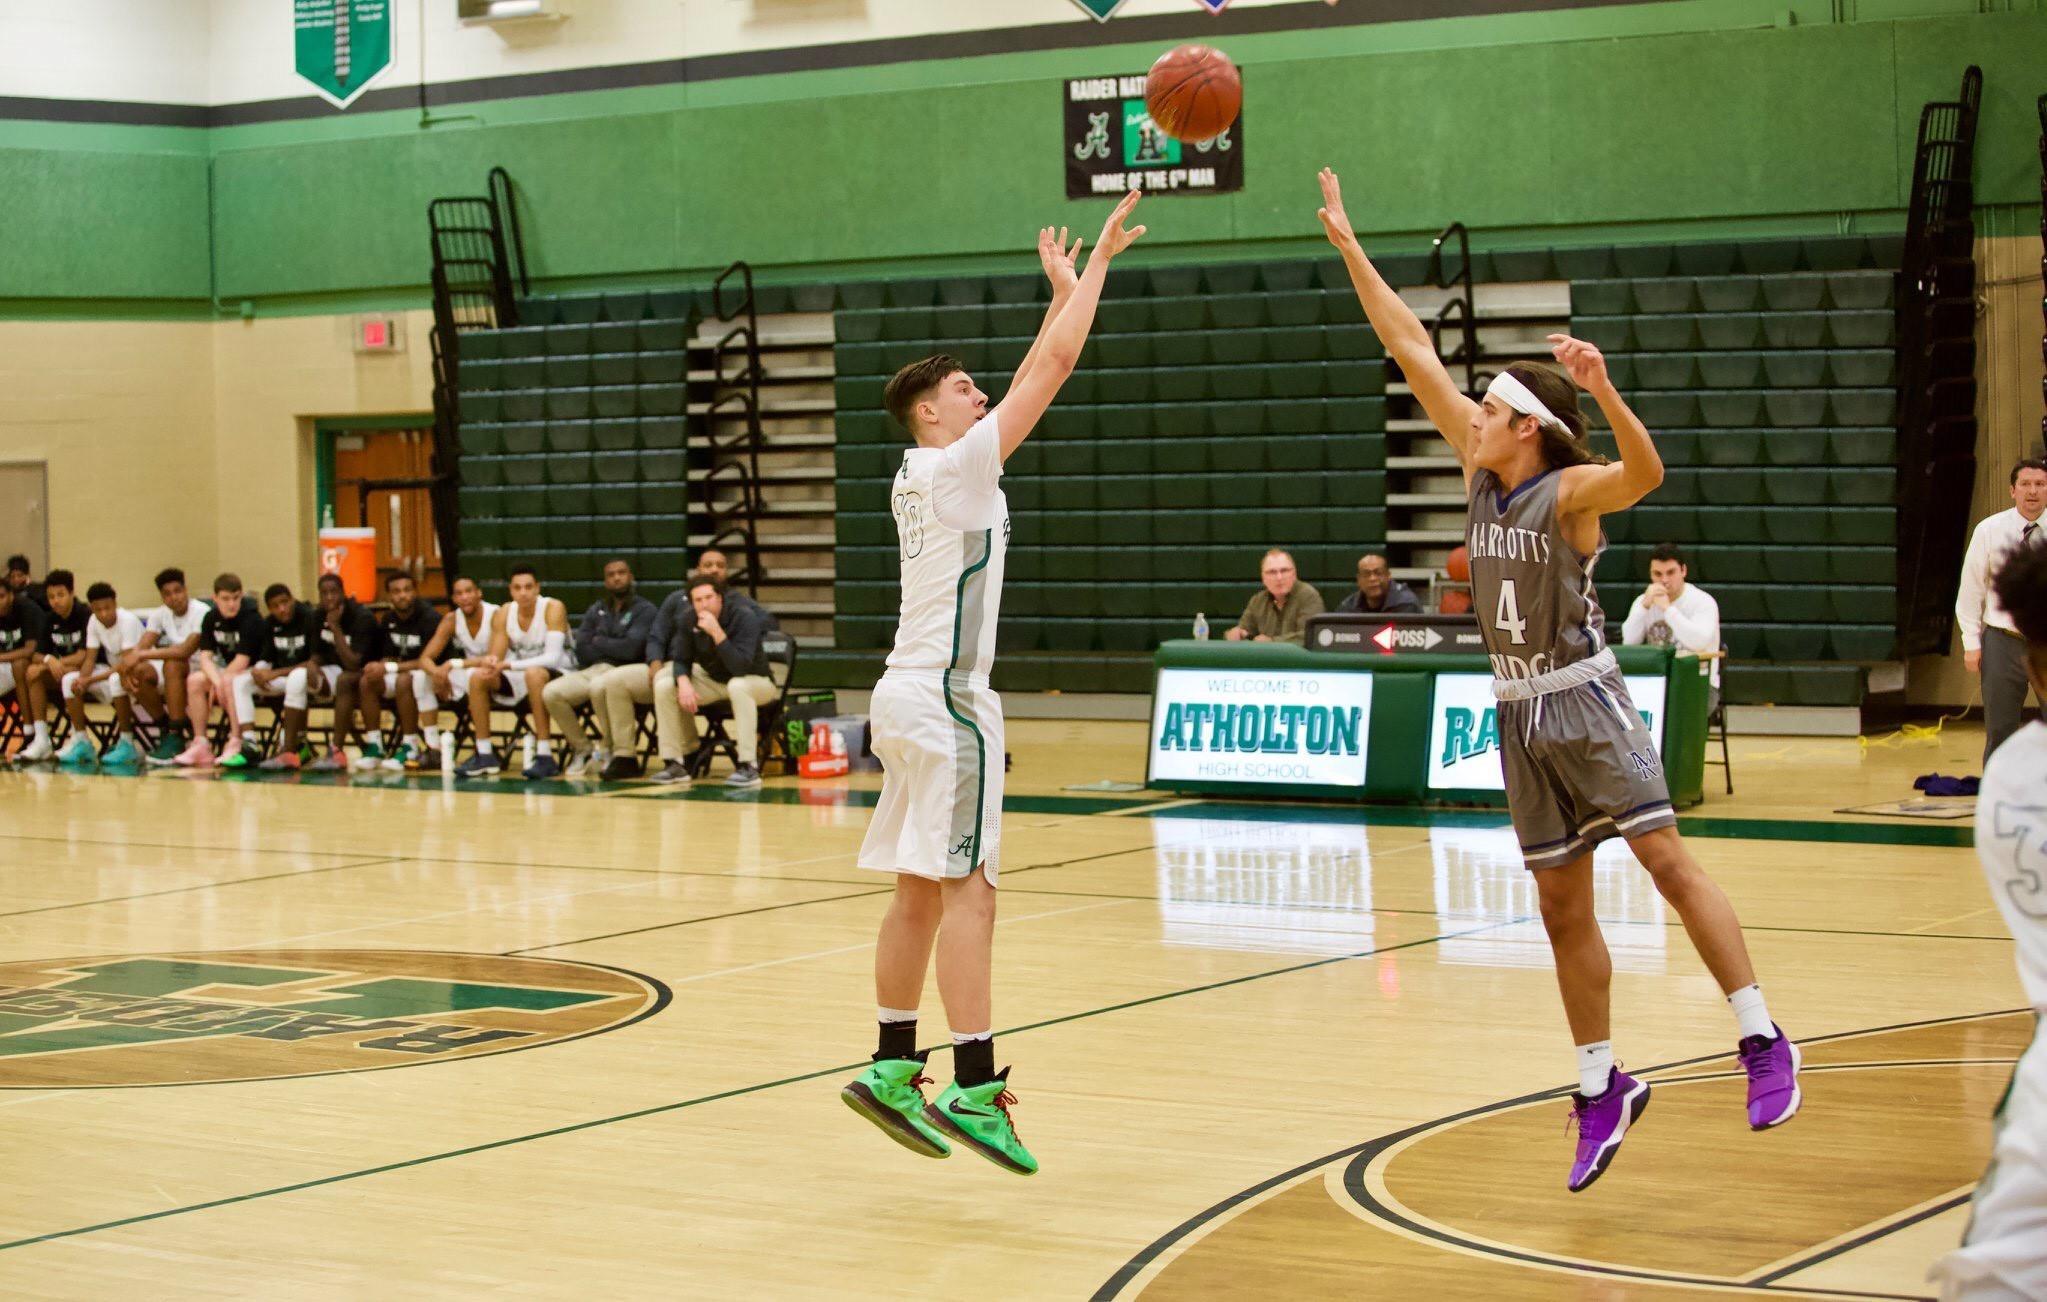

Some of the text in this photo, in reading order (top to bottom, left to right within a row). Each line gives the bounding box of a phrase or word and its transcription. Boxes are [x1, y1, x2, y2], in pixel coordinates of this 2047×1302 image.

[1145, 170, 1168, 190] THE
[1188, 168, 1215, 187] MAN
[1495, 579, 1527, 645] 4
[1391, 629, 1425, 647] POSS
[1488, 652, 1555, 680] RIDG
[1208, 679, 1320, 695] WELCOME TO
[1160, 702, 1362, 755] ATHOLTON
[1198, 762, 1313, 779] HIGH SCHOOL
